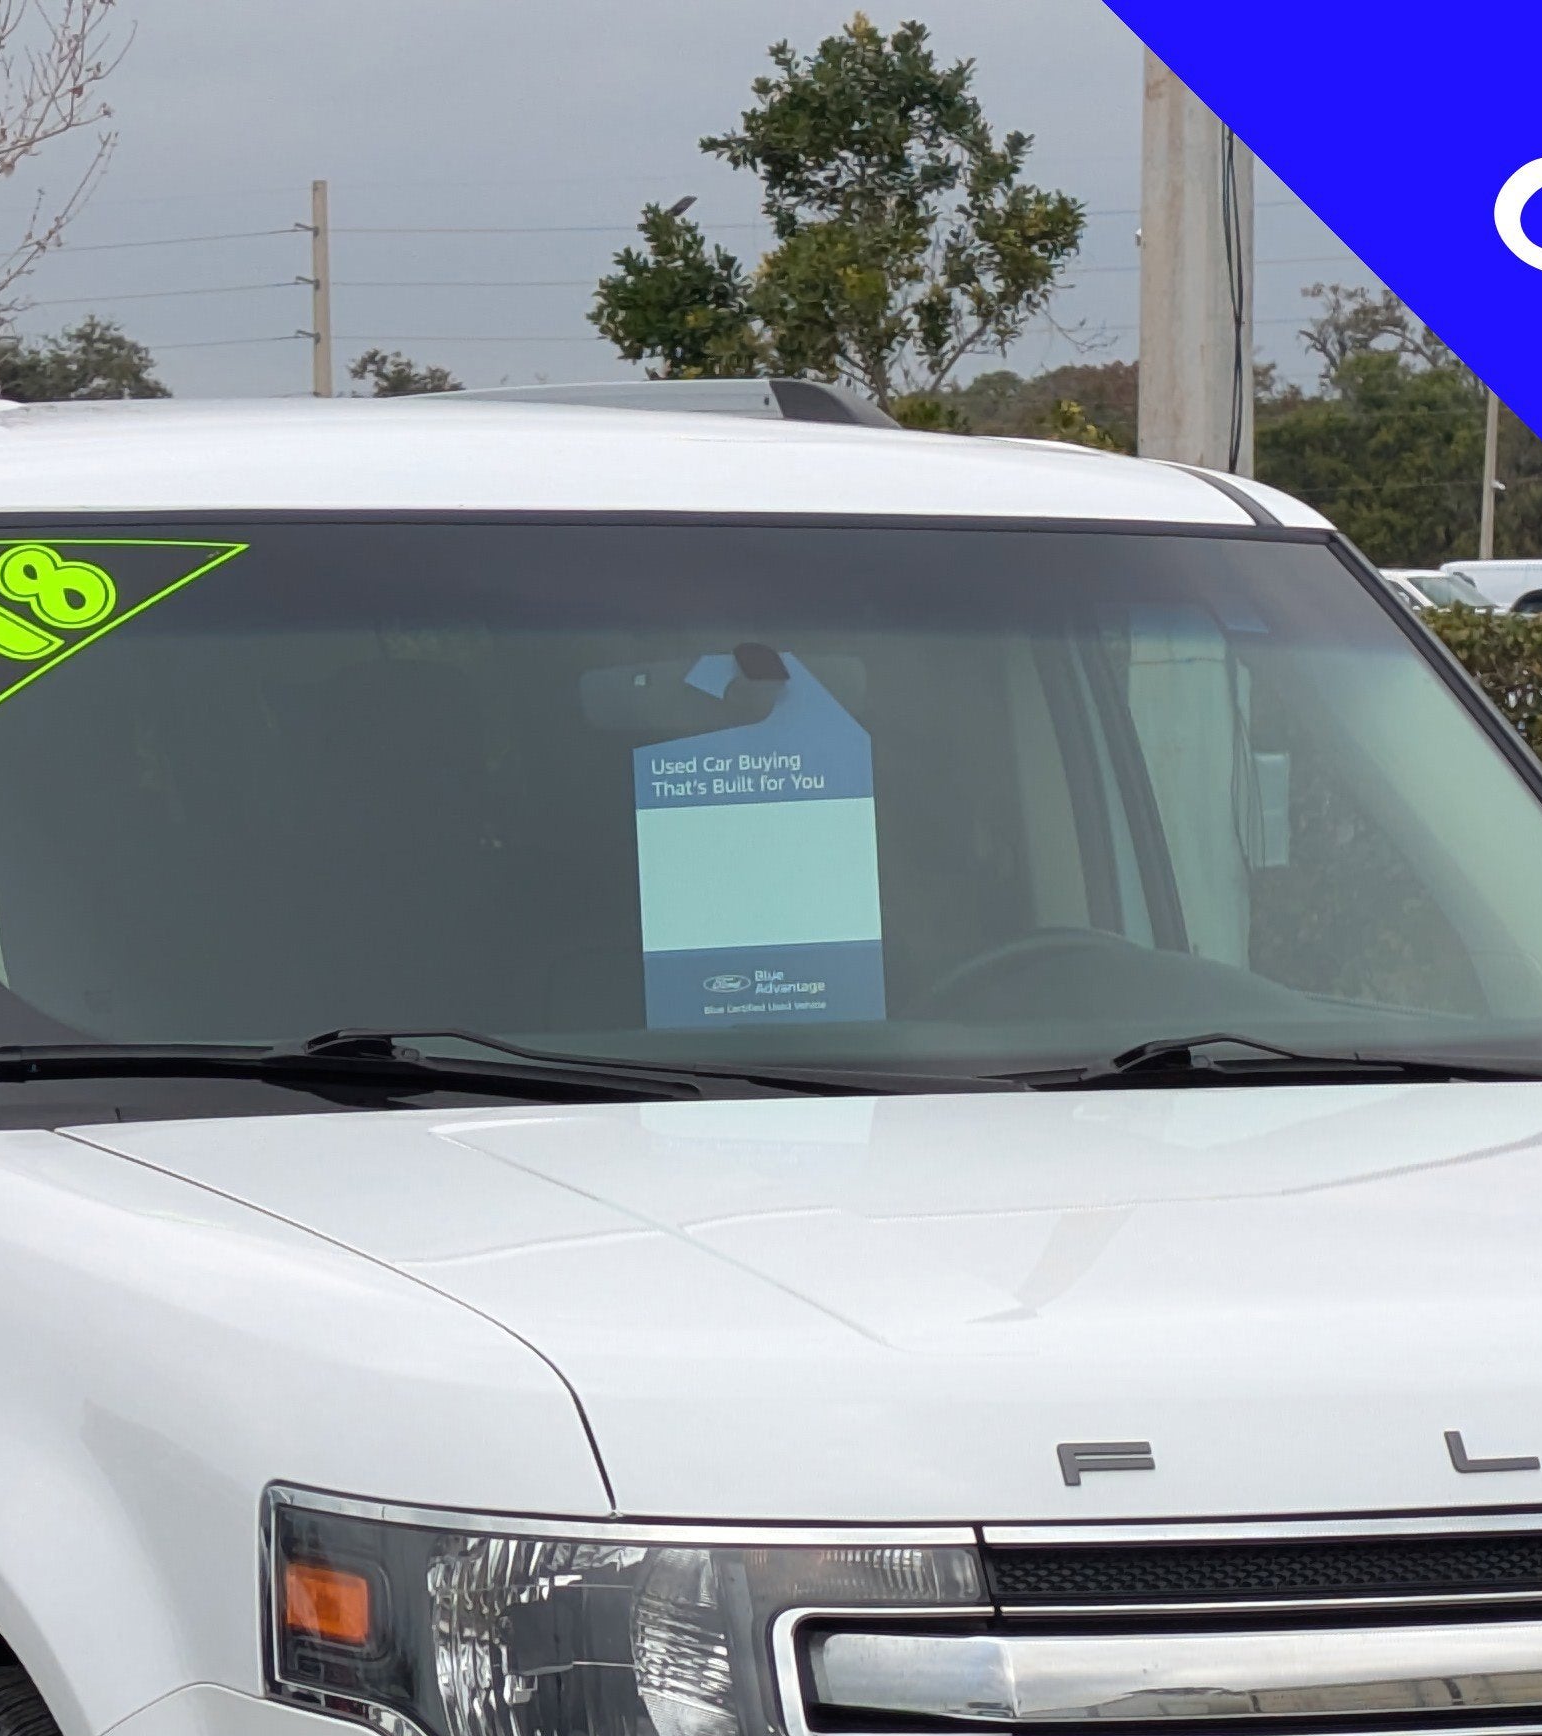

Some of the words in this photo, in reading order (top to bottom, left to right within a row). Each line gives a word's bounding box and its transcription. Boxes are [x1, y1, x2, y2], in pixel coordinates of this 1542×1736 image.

[651, 756, 697, 775] Used
[703, 756, 733, 773] Car
[739, 751, 802, 772] Buying
[652, 780, 707, 797] That's
[713, 776, 754, 794] Built
[760, 775, 785, 791] for
[791, 773, 825, 790] You
[754, 970, 784, 982] Blue
[754, 980, 826, 995] Advantage
